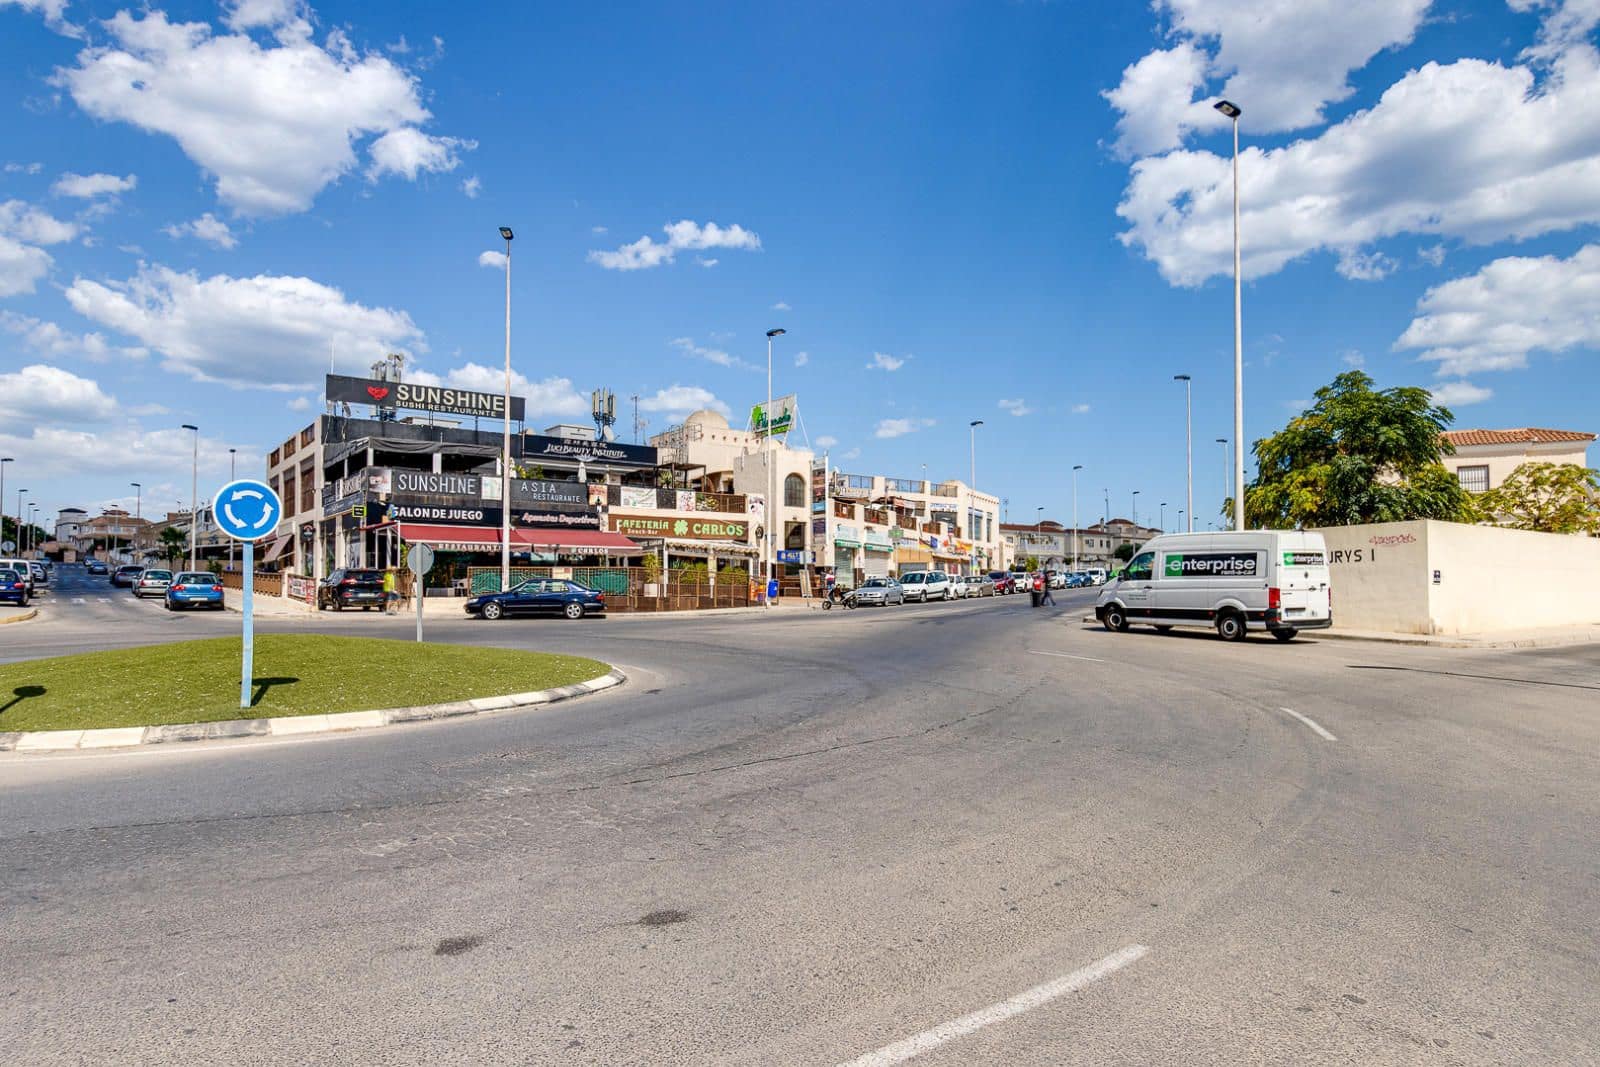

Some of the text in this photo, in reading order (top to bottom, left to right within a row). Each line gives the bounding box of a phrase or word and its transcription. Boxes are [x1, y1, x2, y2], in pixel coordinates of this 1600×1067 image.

[396, 384, 505, 412] SUNSHINE
[395, 401, 497, 417] SUSHI RESTAURANTE
[563, 445, 591, 455] BEAUTY
[592, 447, 627, 458] INSTITUTE
[398, 473, 476, 495] SUNSHINE
[520, 482, 556, 493] ASIA
[533, 494, 580, 503] RESTAURANTE
[393, 506, 483, 520] SALON DE JUEGO
[522, 512, 599, 525] Apuestas Deportivas
[692, 523, 744, 536] CARLOS
[1371, 548, 1376, 562] I
[1170, 556, 1256, 574] enterprise
